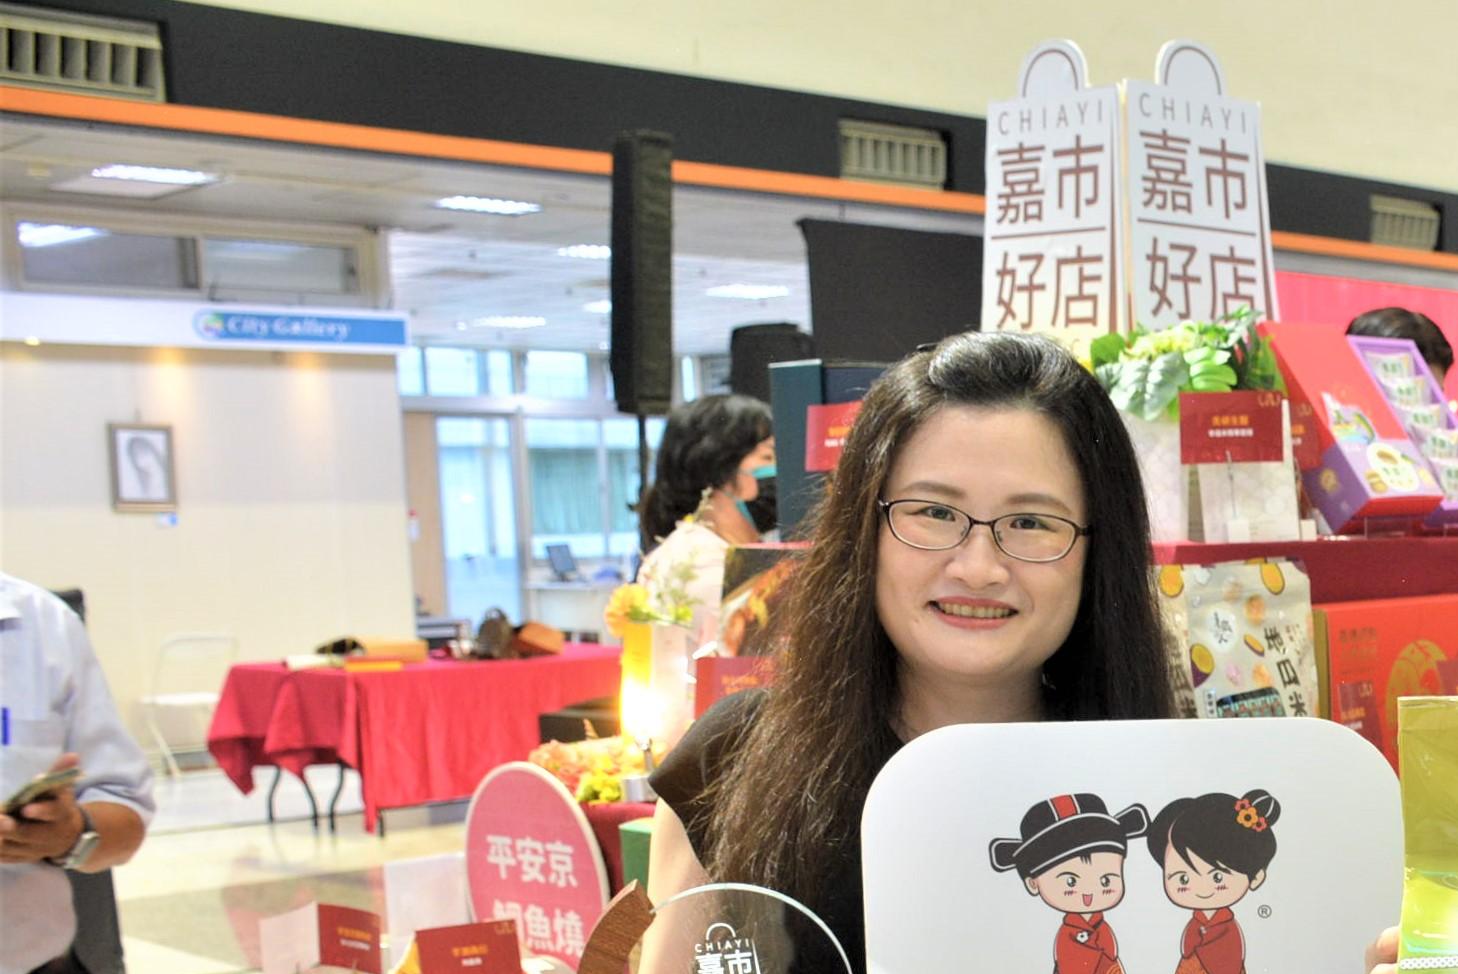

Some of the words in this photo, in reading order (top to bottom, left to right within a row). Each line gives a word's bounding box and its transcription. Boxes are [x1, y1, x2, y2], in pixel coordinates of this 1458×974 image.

[996, 100, 1103, 136] CHIAYI
[1138, 92, 1248, 136] CHIAYI
[995, 134, 1105, 225] 嘉市
[1138, 128, 1250, 221] 嘉市
[995, 245, 1105, 331] 好店
[1145, 235, 1258, 323] 好店
[227, 315, 268, 336] City
[272, 317, 349, 342] Gallery
[486, 833, 578, 888] 平安京
[694, 937, 750, 953] CHIAYI
